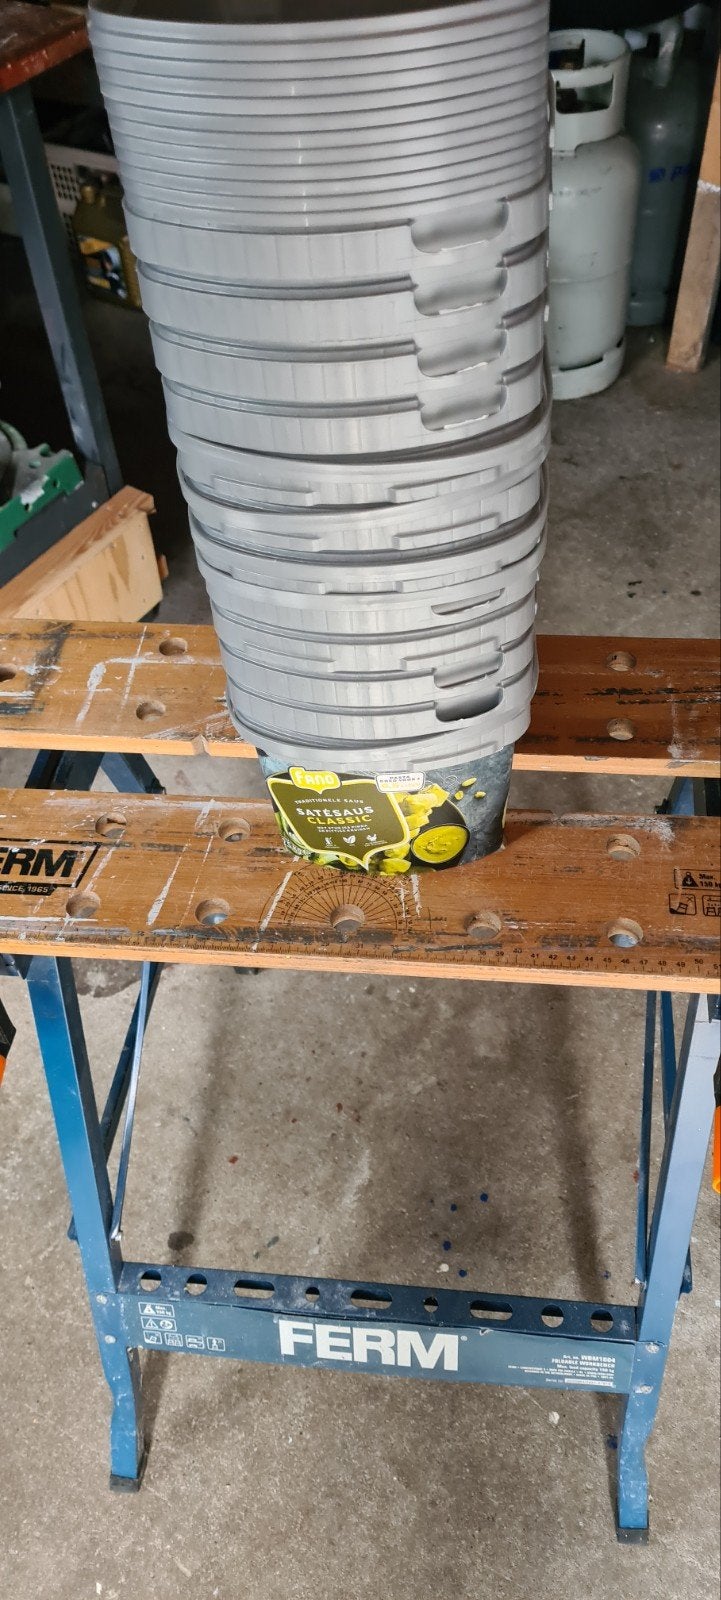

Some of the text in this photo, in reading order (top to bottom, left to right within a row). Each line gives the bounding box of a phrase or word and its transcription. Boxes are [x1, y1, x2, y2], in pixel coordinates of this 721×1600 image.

[296, 806, 374, 817] SATÉSAUS
[307, 815, 372, 825] CLASSIC
[580, 1360, 616, 1368] WORKBENCH
